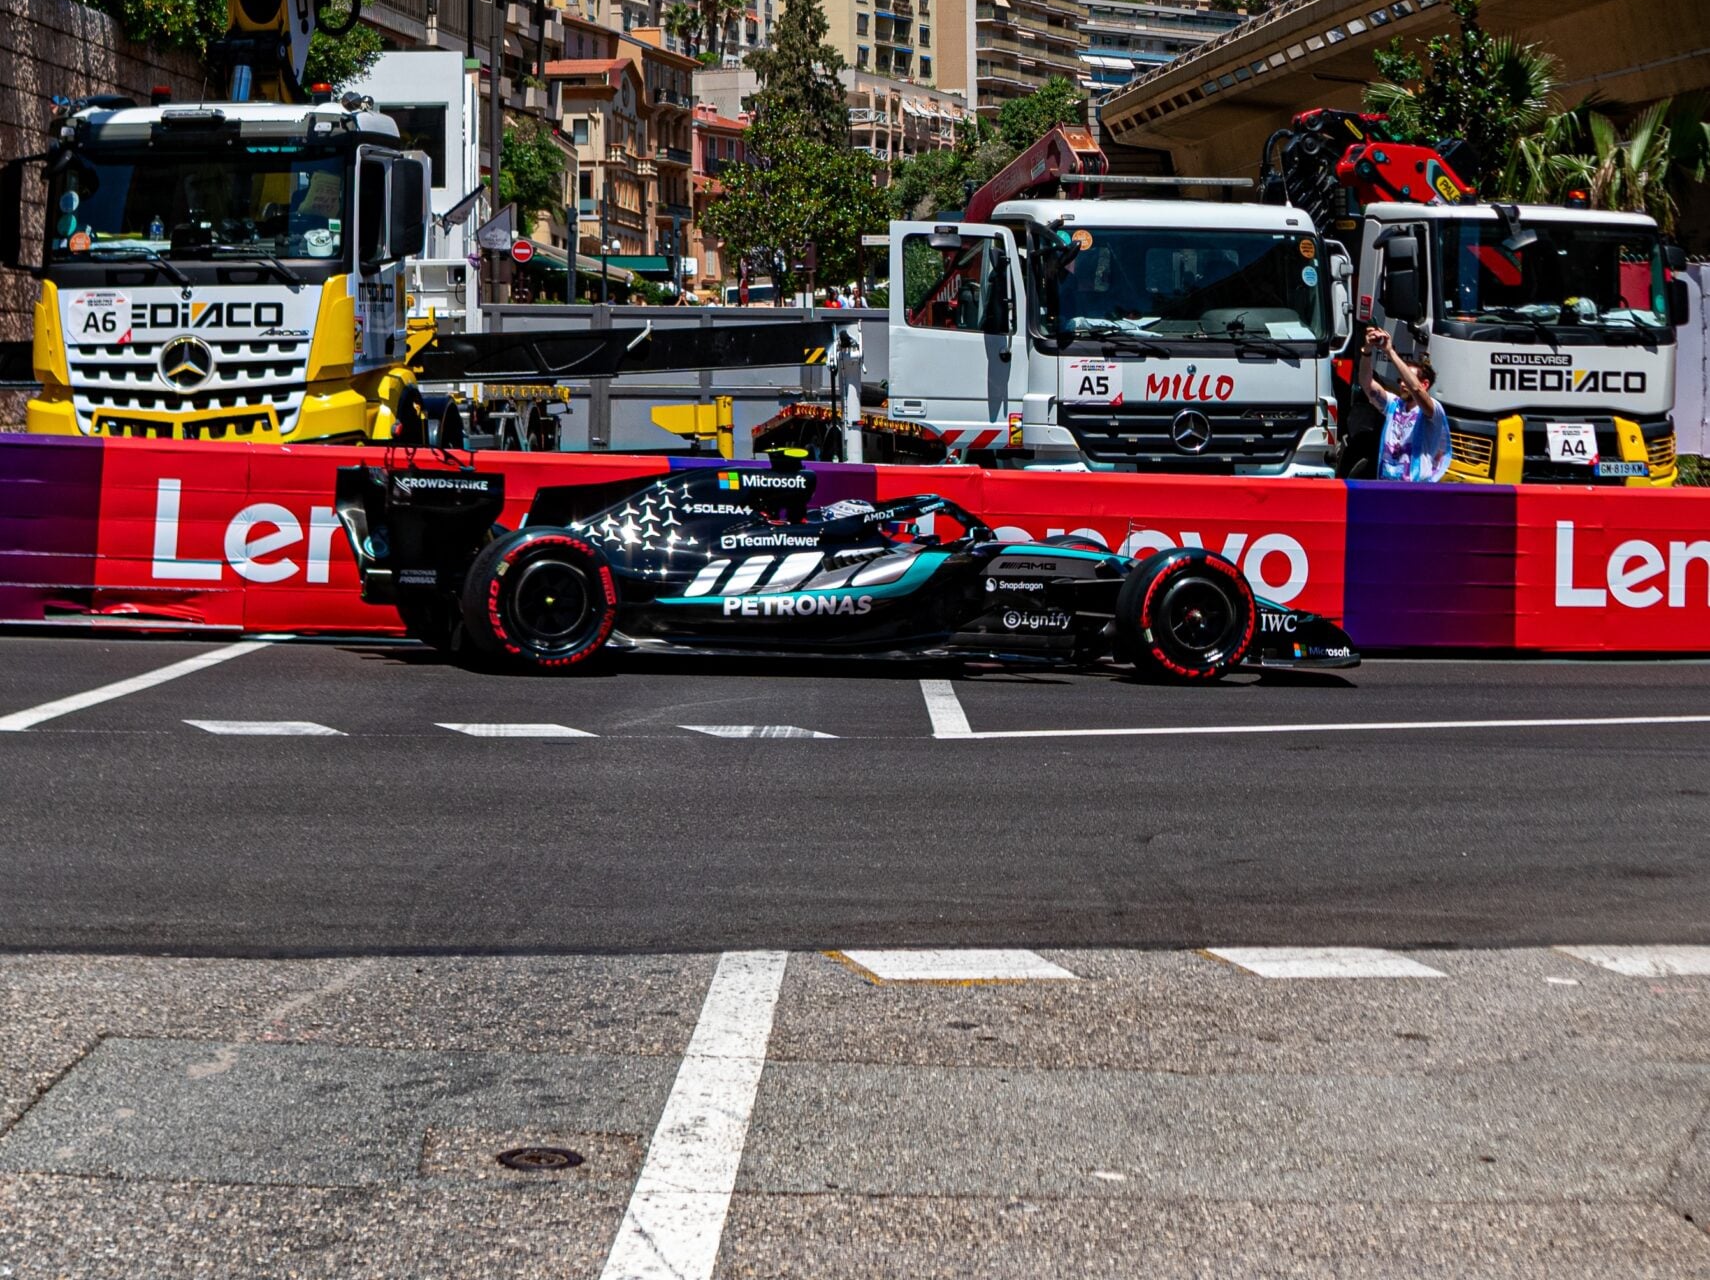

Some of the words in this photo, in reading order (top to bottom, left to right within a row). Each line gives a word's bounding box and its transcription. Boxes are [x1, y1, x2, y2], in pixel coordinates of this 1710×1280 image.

[82, 311, 117, 334] A6
[131, 303, 283, 329] EDiACO
[1512, 355, 1527, 364] DU
[1528, 355, 1569, 365] LEVAGE
[1078, 375, 1109, 396] A5
[1146, 373, 1234, 401] MILLO
[1561, 440, 1587, 457] A4
[401, 477, 489, 491] CROWDSTRIKE
[742, 474, 806, 489] Microsoft
[694, 503, 744, 515] SOLERA
[864, 511, 886, 523] AMD
[737, 533, 820, 547] TeamViewer
[1018, 562, 1057, 571] AMG
[1000, 581, 1043, 591] Snapdragon
[723, 595, 873, 616] PETRONAS
[1261, 613, 1298, 632] IWC
[1308, 646, 1350, 657] Microsoft
